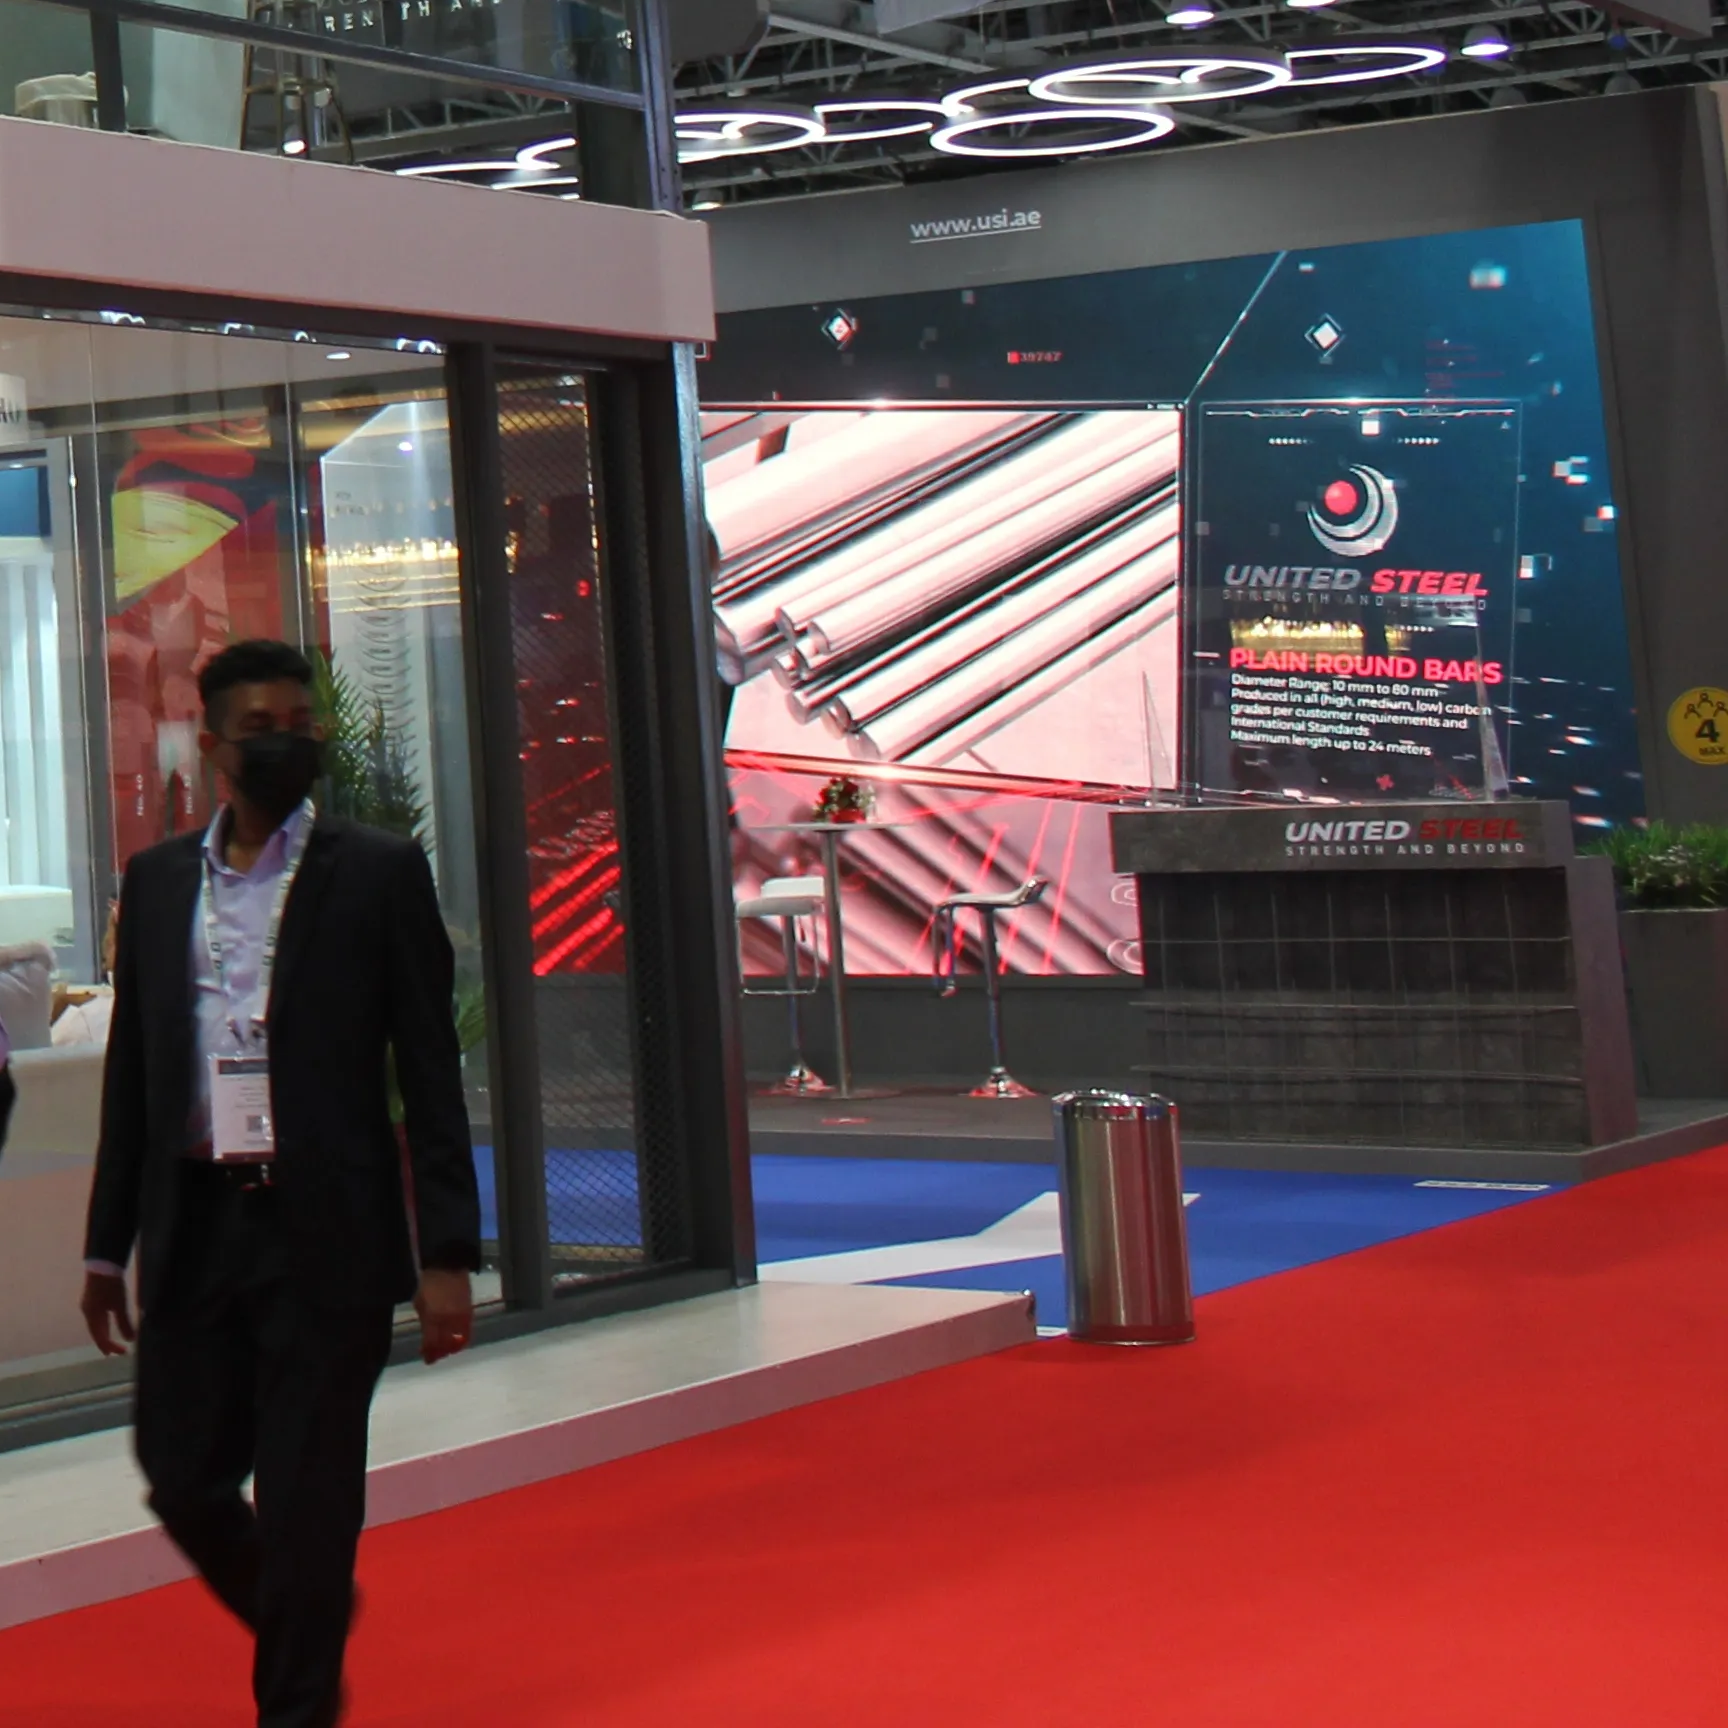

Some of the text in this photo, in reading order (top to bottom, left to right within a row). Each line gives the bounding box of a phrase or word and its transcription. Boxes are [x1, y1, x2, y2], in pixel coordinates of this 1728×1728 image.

[910, 208, 1042, 240] www.usi.ae
[1224, 564, 1489, 597] UNITED STEEL
[1223, 589, 1330, 605] STRENGTH
[1344, 594, 1384, 607] AND
[1229, 647, 1503, 685] PLAIN ROUND BARS
[1231, 673, 1287, 689] Diameter
[1332, 679, 1346, 692] 10
[1348, 682, 1374, 694] mm
[1376, 683, 1389, 695] to
[1411, 687, 1440, 699] mm
[1231, 687, 1288, 703] Produced
[1290, 690, 1302, 703] in
[1304, 691, 1319, 705] all
[1416, 699, 1443, 715] low)
[1230, 702, 1468, 730] grades per customer requirements and
[1231, 716, 1370, 737] International Standards
[1230, 729, 1432, 757] Maximum length up to 24 meters
[1695, 718, 1720, 743] 4
[1285, 818, 1525, 842] UNITED STEEL
[1286, 843, 1524, 857] STRENGTH AND BEYOND
